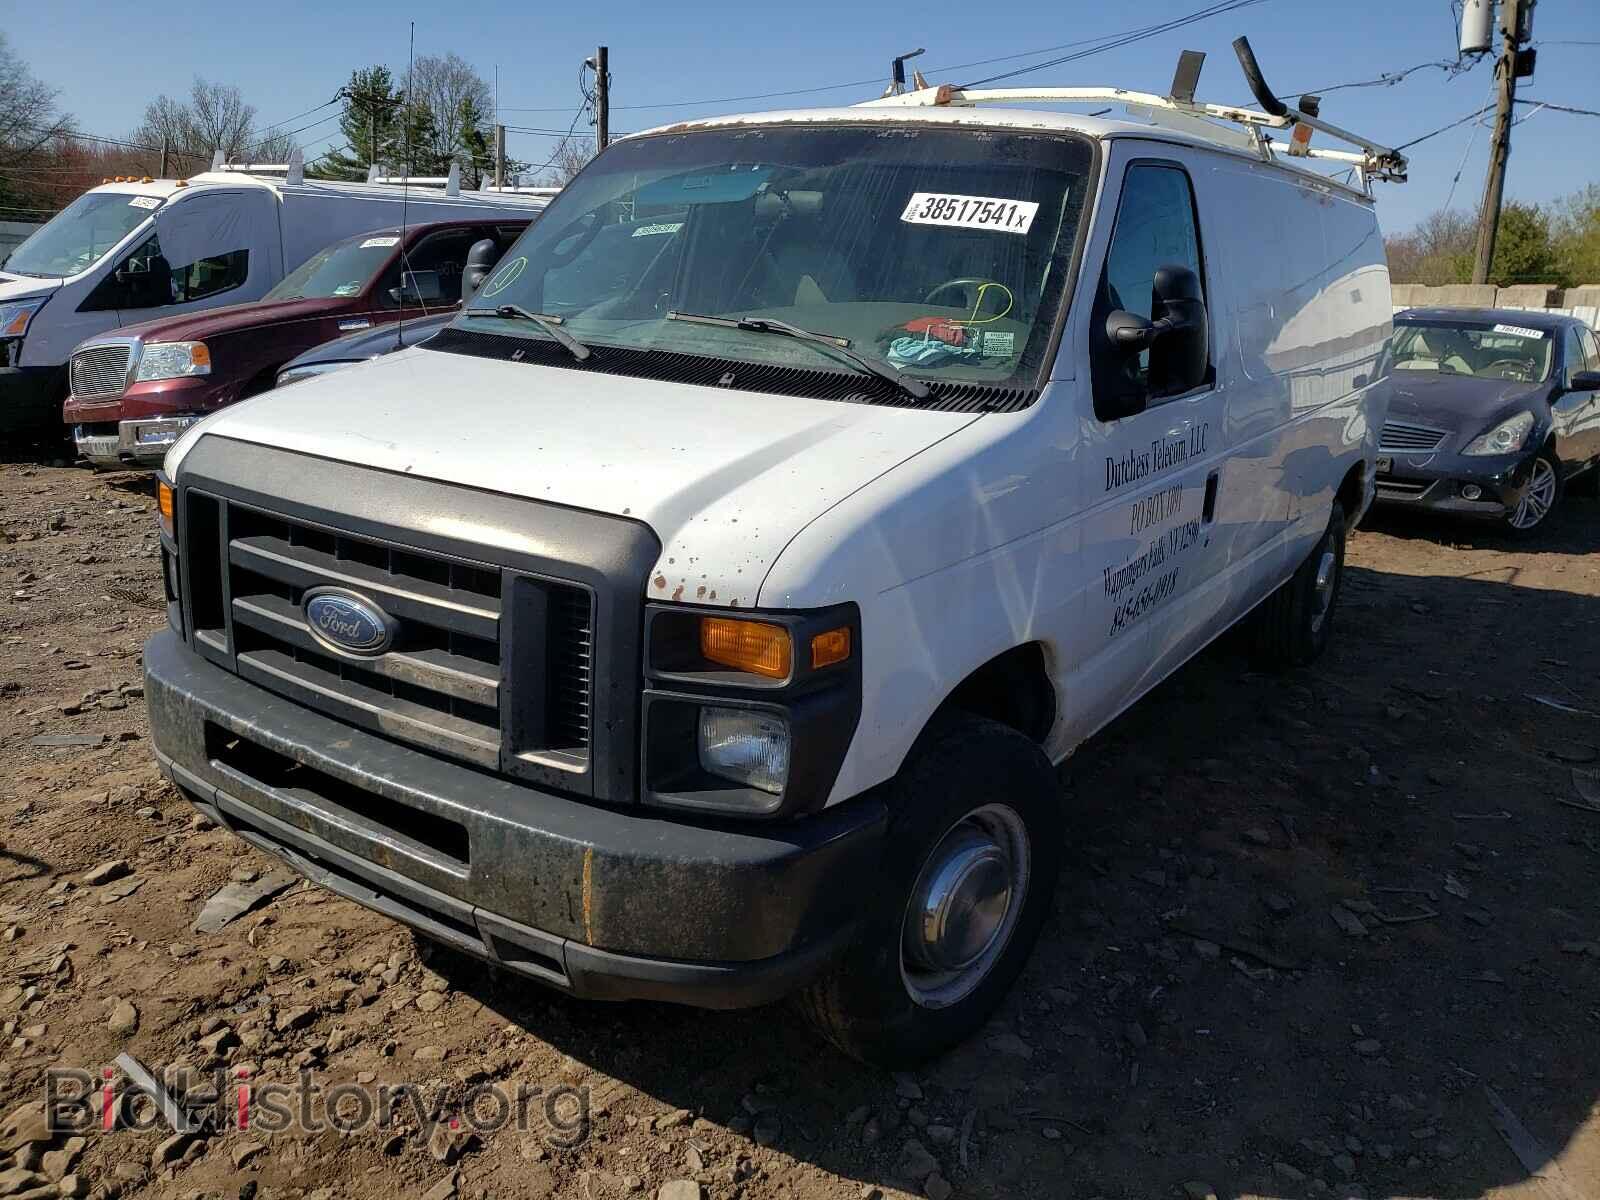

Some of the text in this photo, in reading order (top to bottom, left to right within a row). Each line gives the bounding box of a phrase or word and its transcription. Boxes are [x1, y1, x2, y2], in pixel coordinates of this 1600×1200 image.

[919, 197, 1018, 227] 38517541
[1105, 423, 1209, 491] Dutchess Telecom, LLC
[1130, 500, 1145, 535] PO
[1145, 489, 1167, 529] BOX
[1103, 553, 1149, 602] Wappingers
[319, 604, 362, 638] Ford
